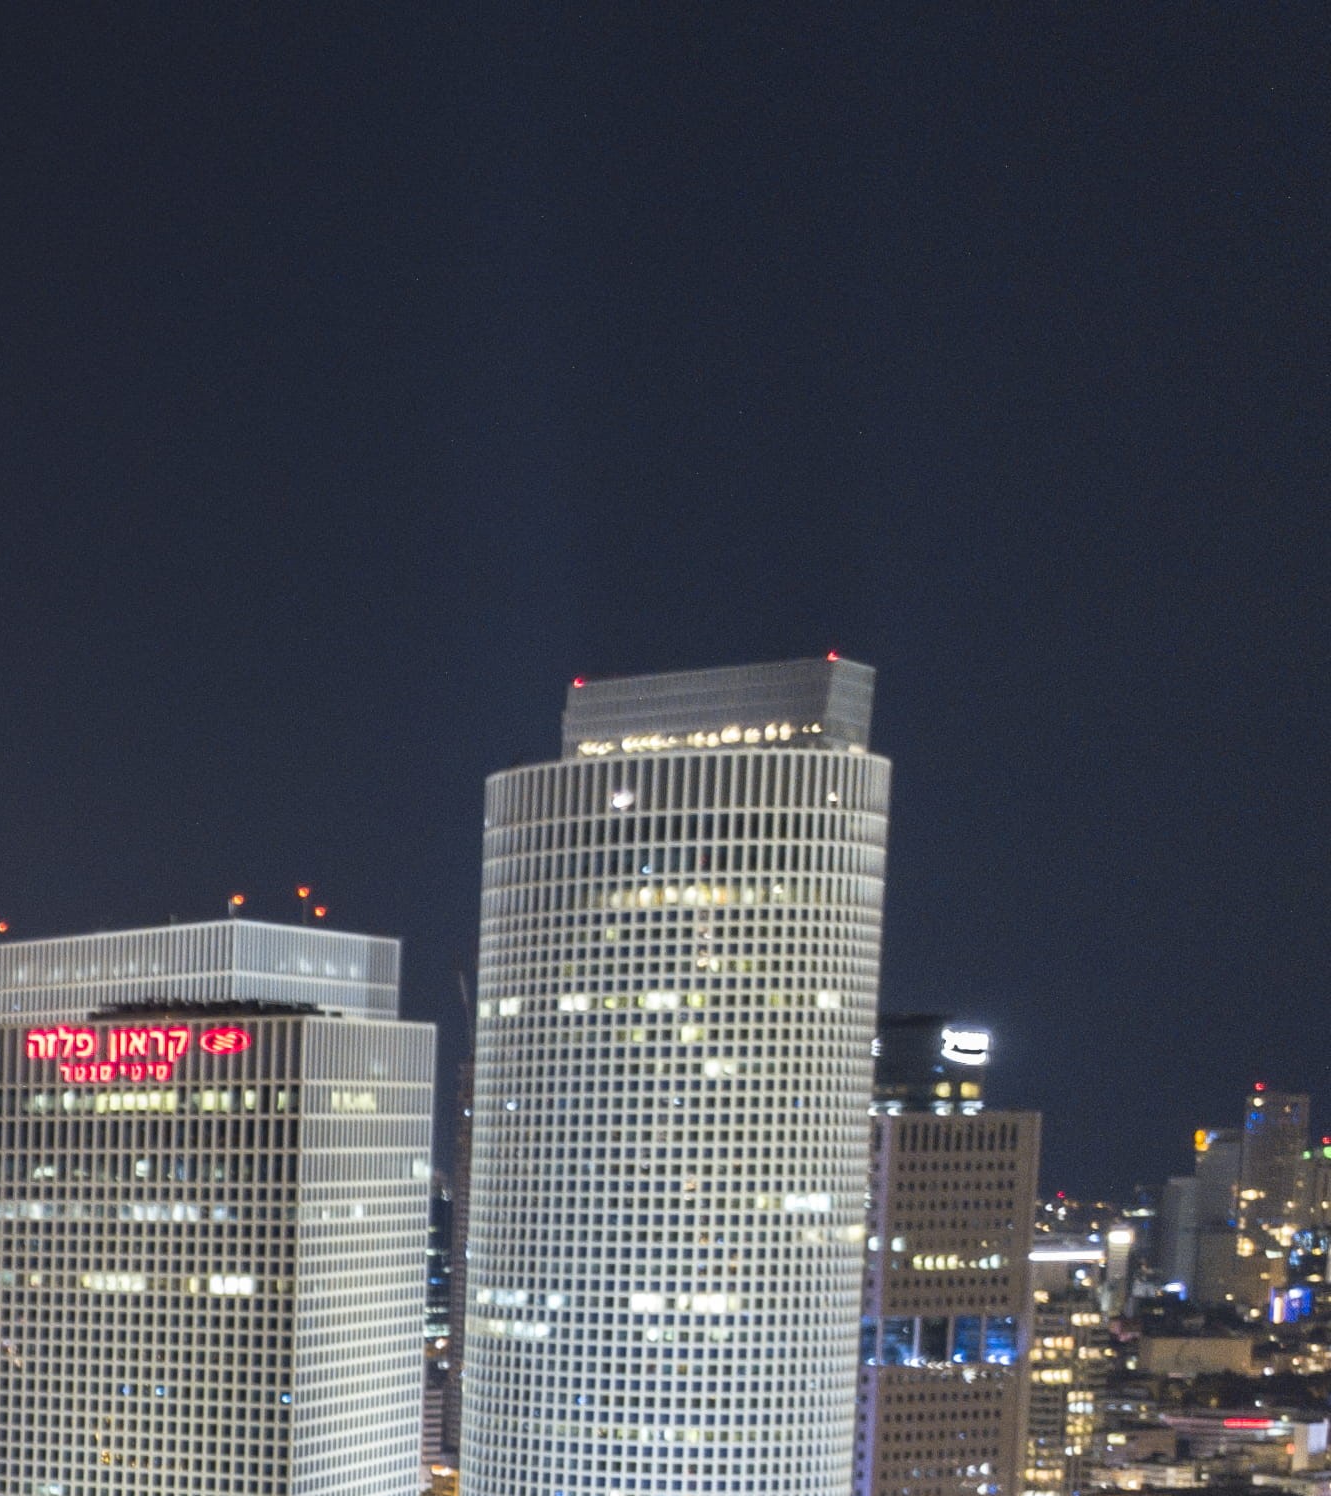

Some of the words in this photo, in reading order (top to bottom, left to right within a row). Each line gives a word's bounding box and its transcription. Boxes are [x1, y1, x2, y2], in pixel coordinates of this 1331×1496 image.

[27, 1026, 96, 1058] פלזה
[109, 1029, 189, 1063] קראון
[59, 1064, 113, 1082] סנטר
[119, 1064, 169, 1082] סיטי
